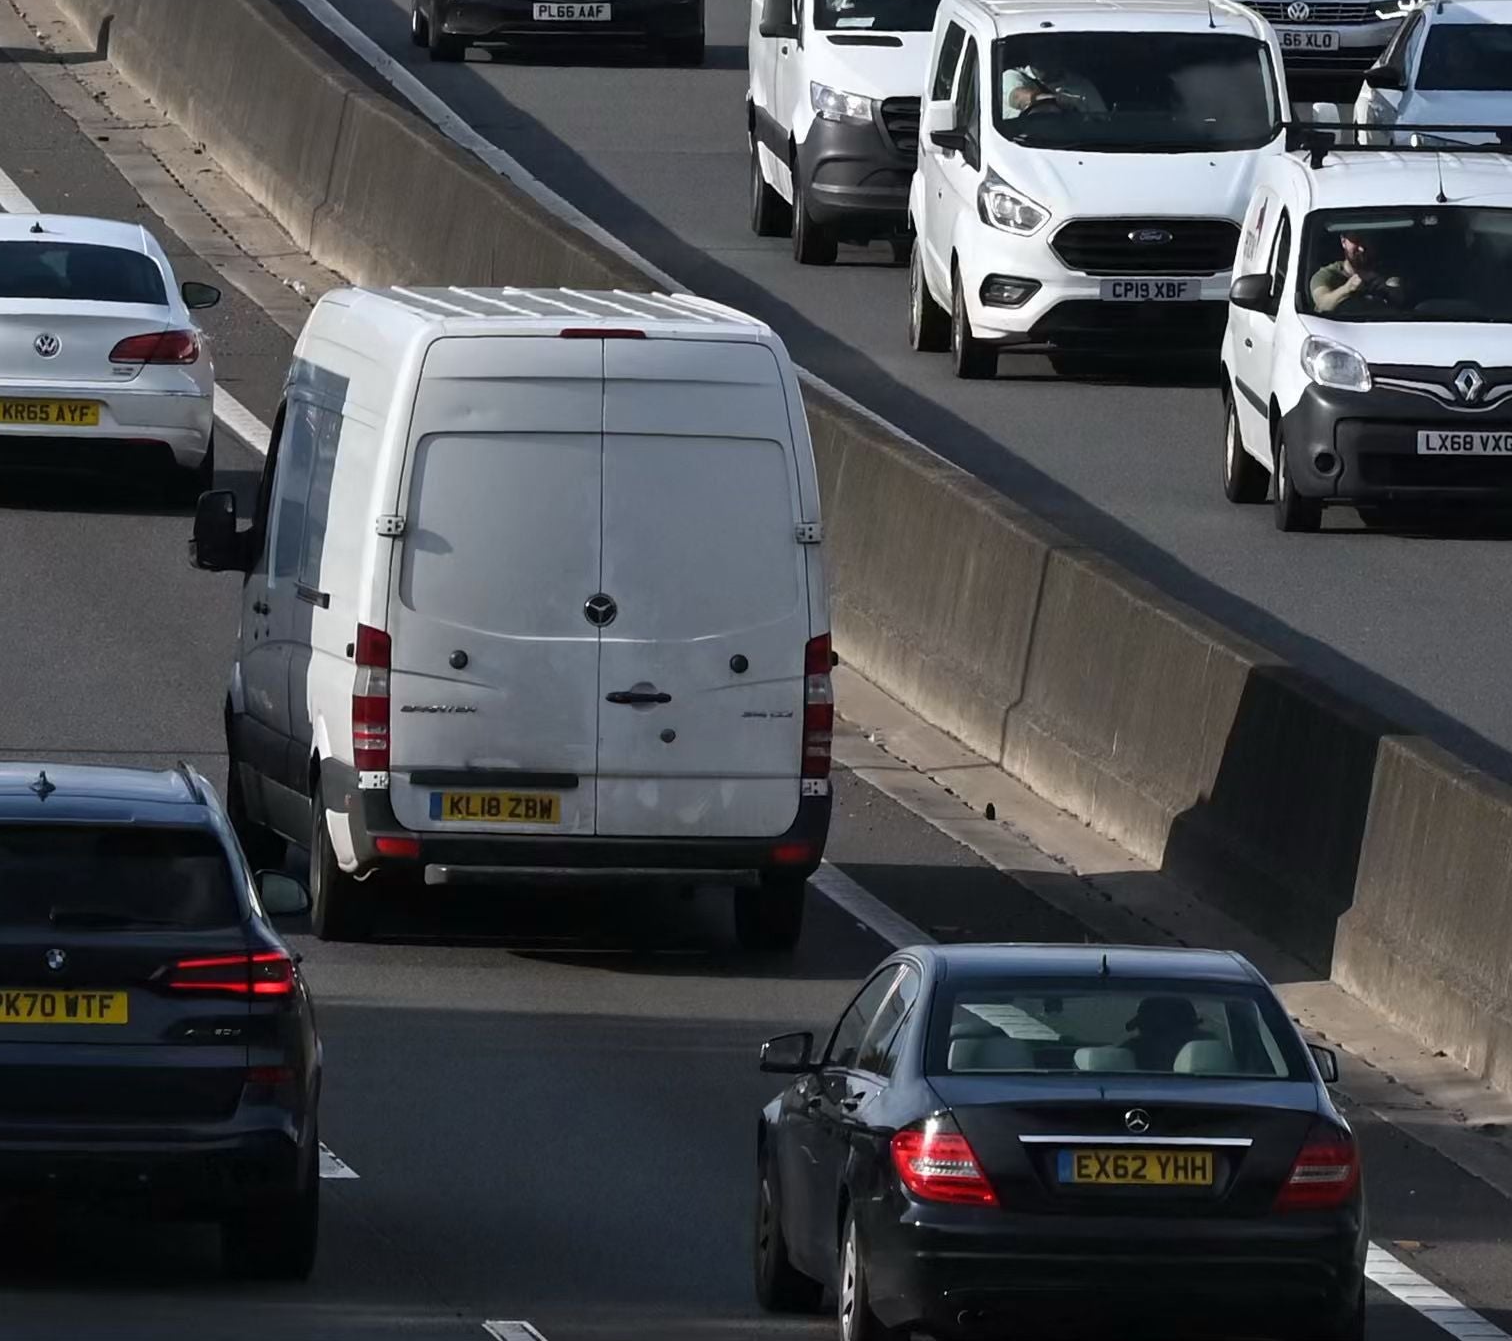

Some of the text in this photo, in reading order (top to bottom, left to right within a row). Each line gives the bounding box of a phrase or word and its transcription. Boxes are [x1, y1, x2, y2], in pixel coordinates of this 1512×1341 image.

[538, 5, 603, 18] PL66 AAF
[1112, 281, 1153, 298] CP19
[1, 404, 91, 422] KR65 AYF
[1426, 434, 1474, 452] LX68
[448, 796, 553, 822] KL18 ZBW
[63, 994, 115, 1018] WTF
[1073, 1153, 1211, 1184] EX62 YHH
